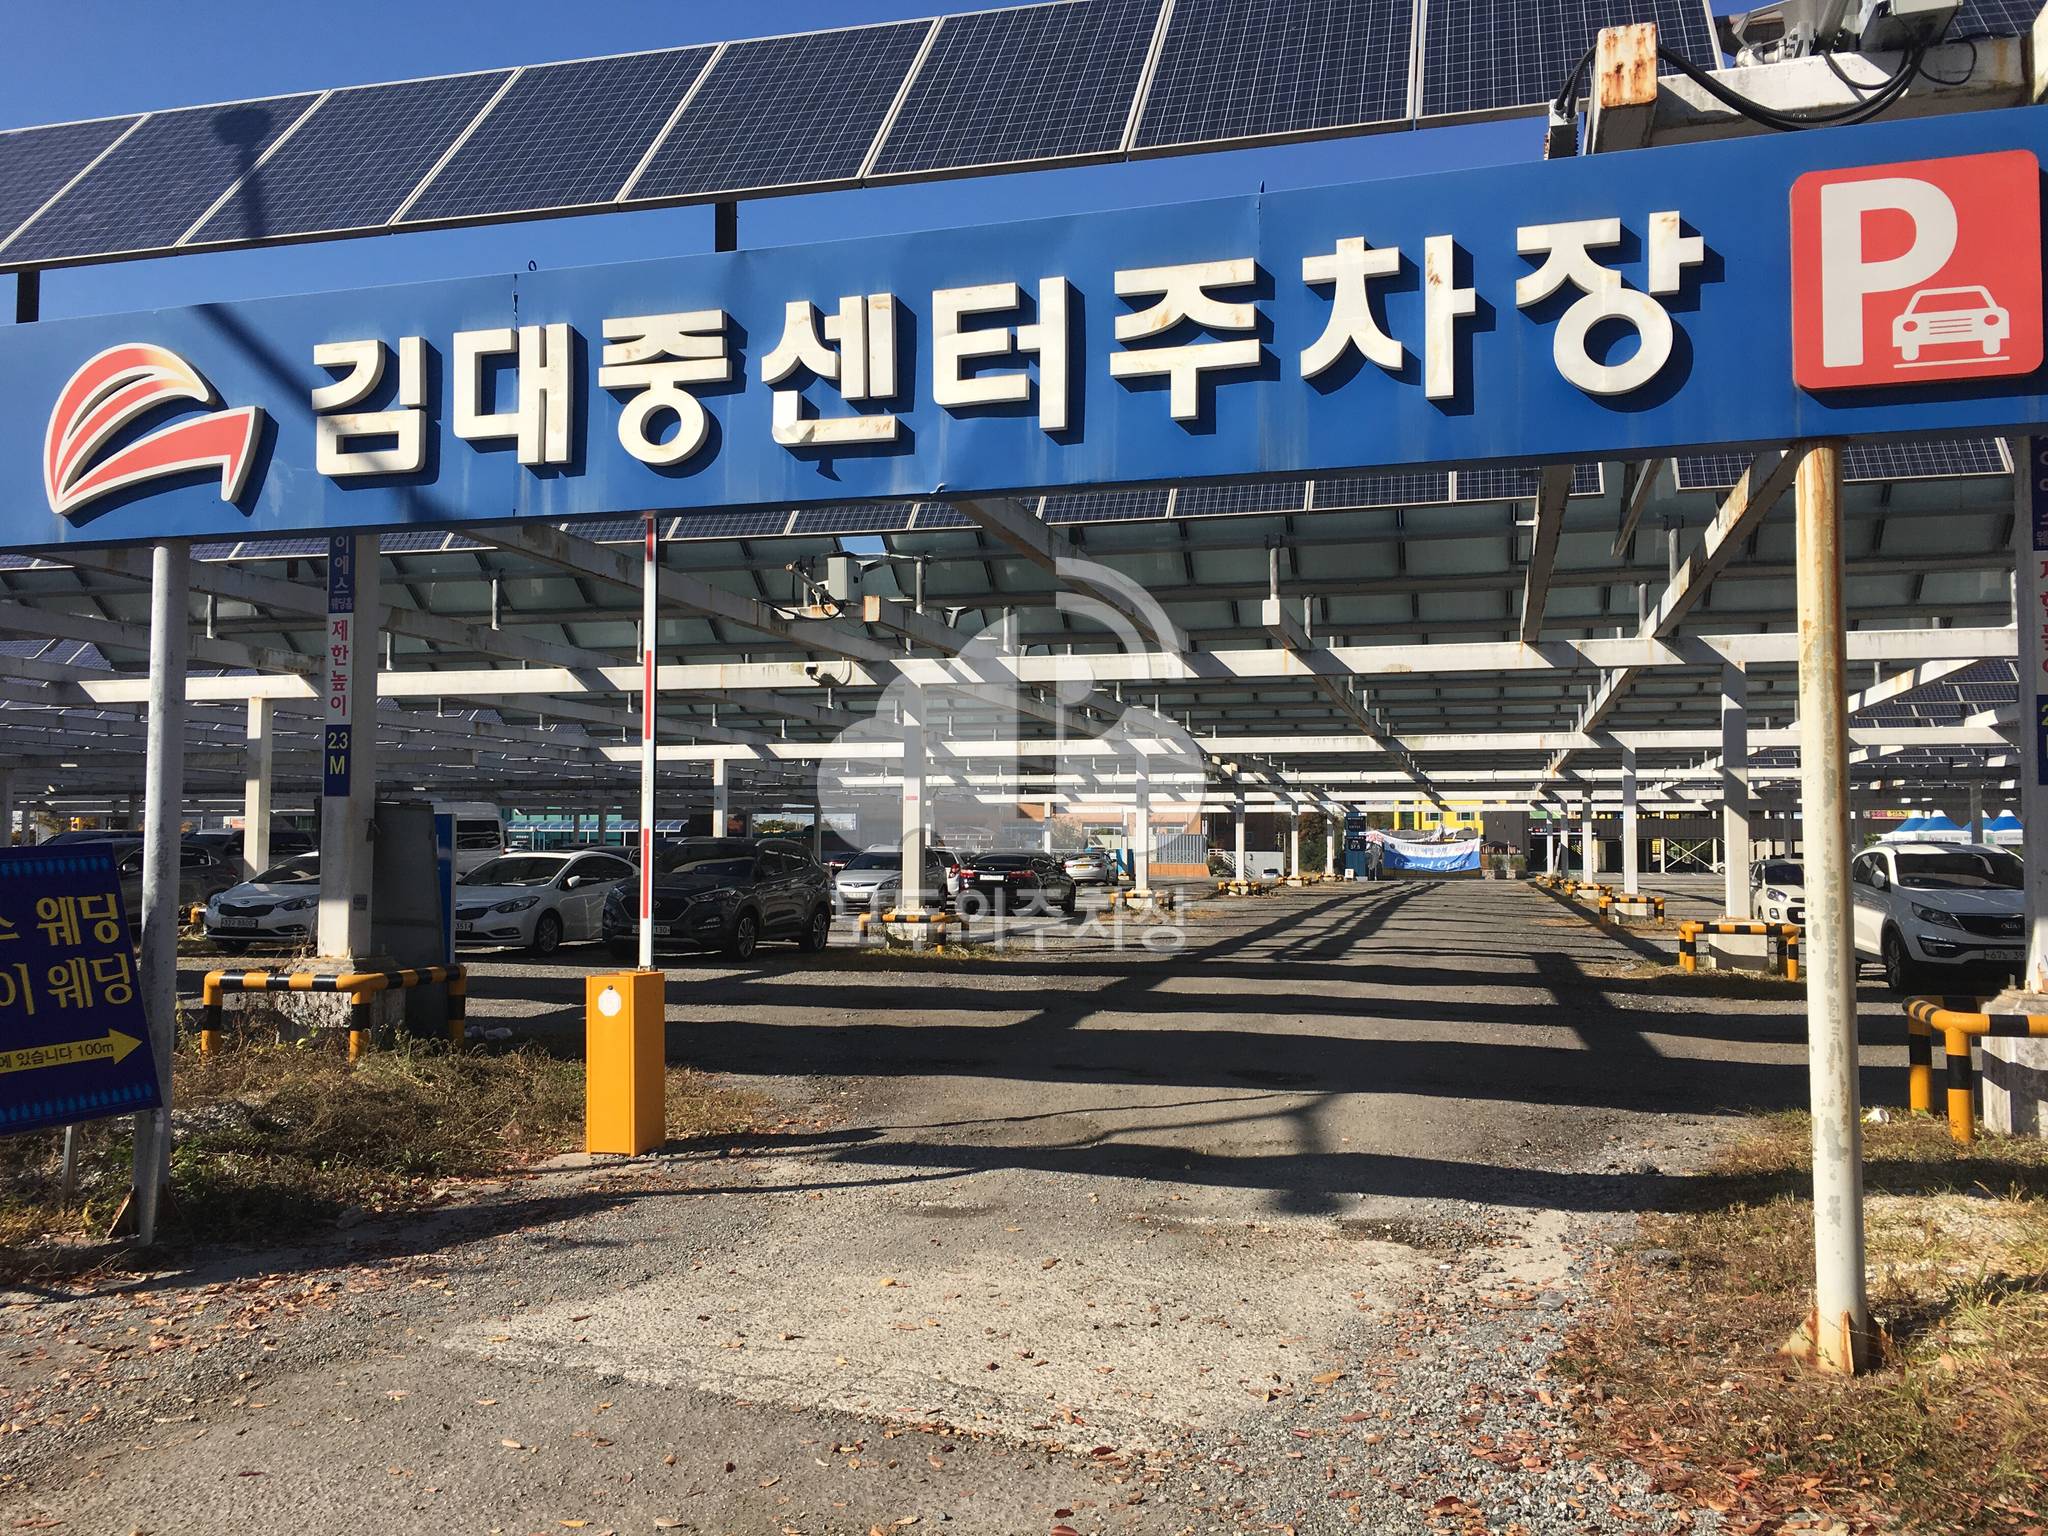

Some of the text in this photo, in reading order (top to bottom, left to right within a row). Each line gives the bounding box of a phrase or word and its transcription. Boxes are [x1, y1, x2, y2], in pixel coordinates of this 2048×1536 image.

[1820, 177, 1957, 368] P
[311, 210, 1705, 477] 김대중센터주차장
[330, 619, 349, 717] 제한높이
[327, 731, 348, 750] 2.3
[329, 755, 345, 775] M
[36, 893, 120, 946] 웨딩
[48, 953, 133, 1009] 웨딩
[16, 1045, 73, 1067] 있습니다
[77, 1041, 115, 1057] 100m
